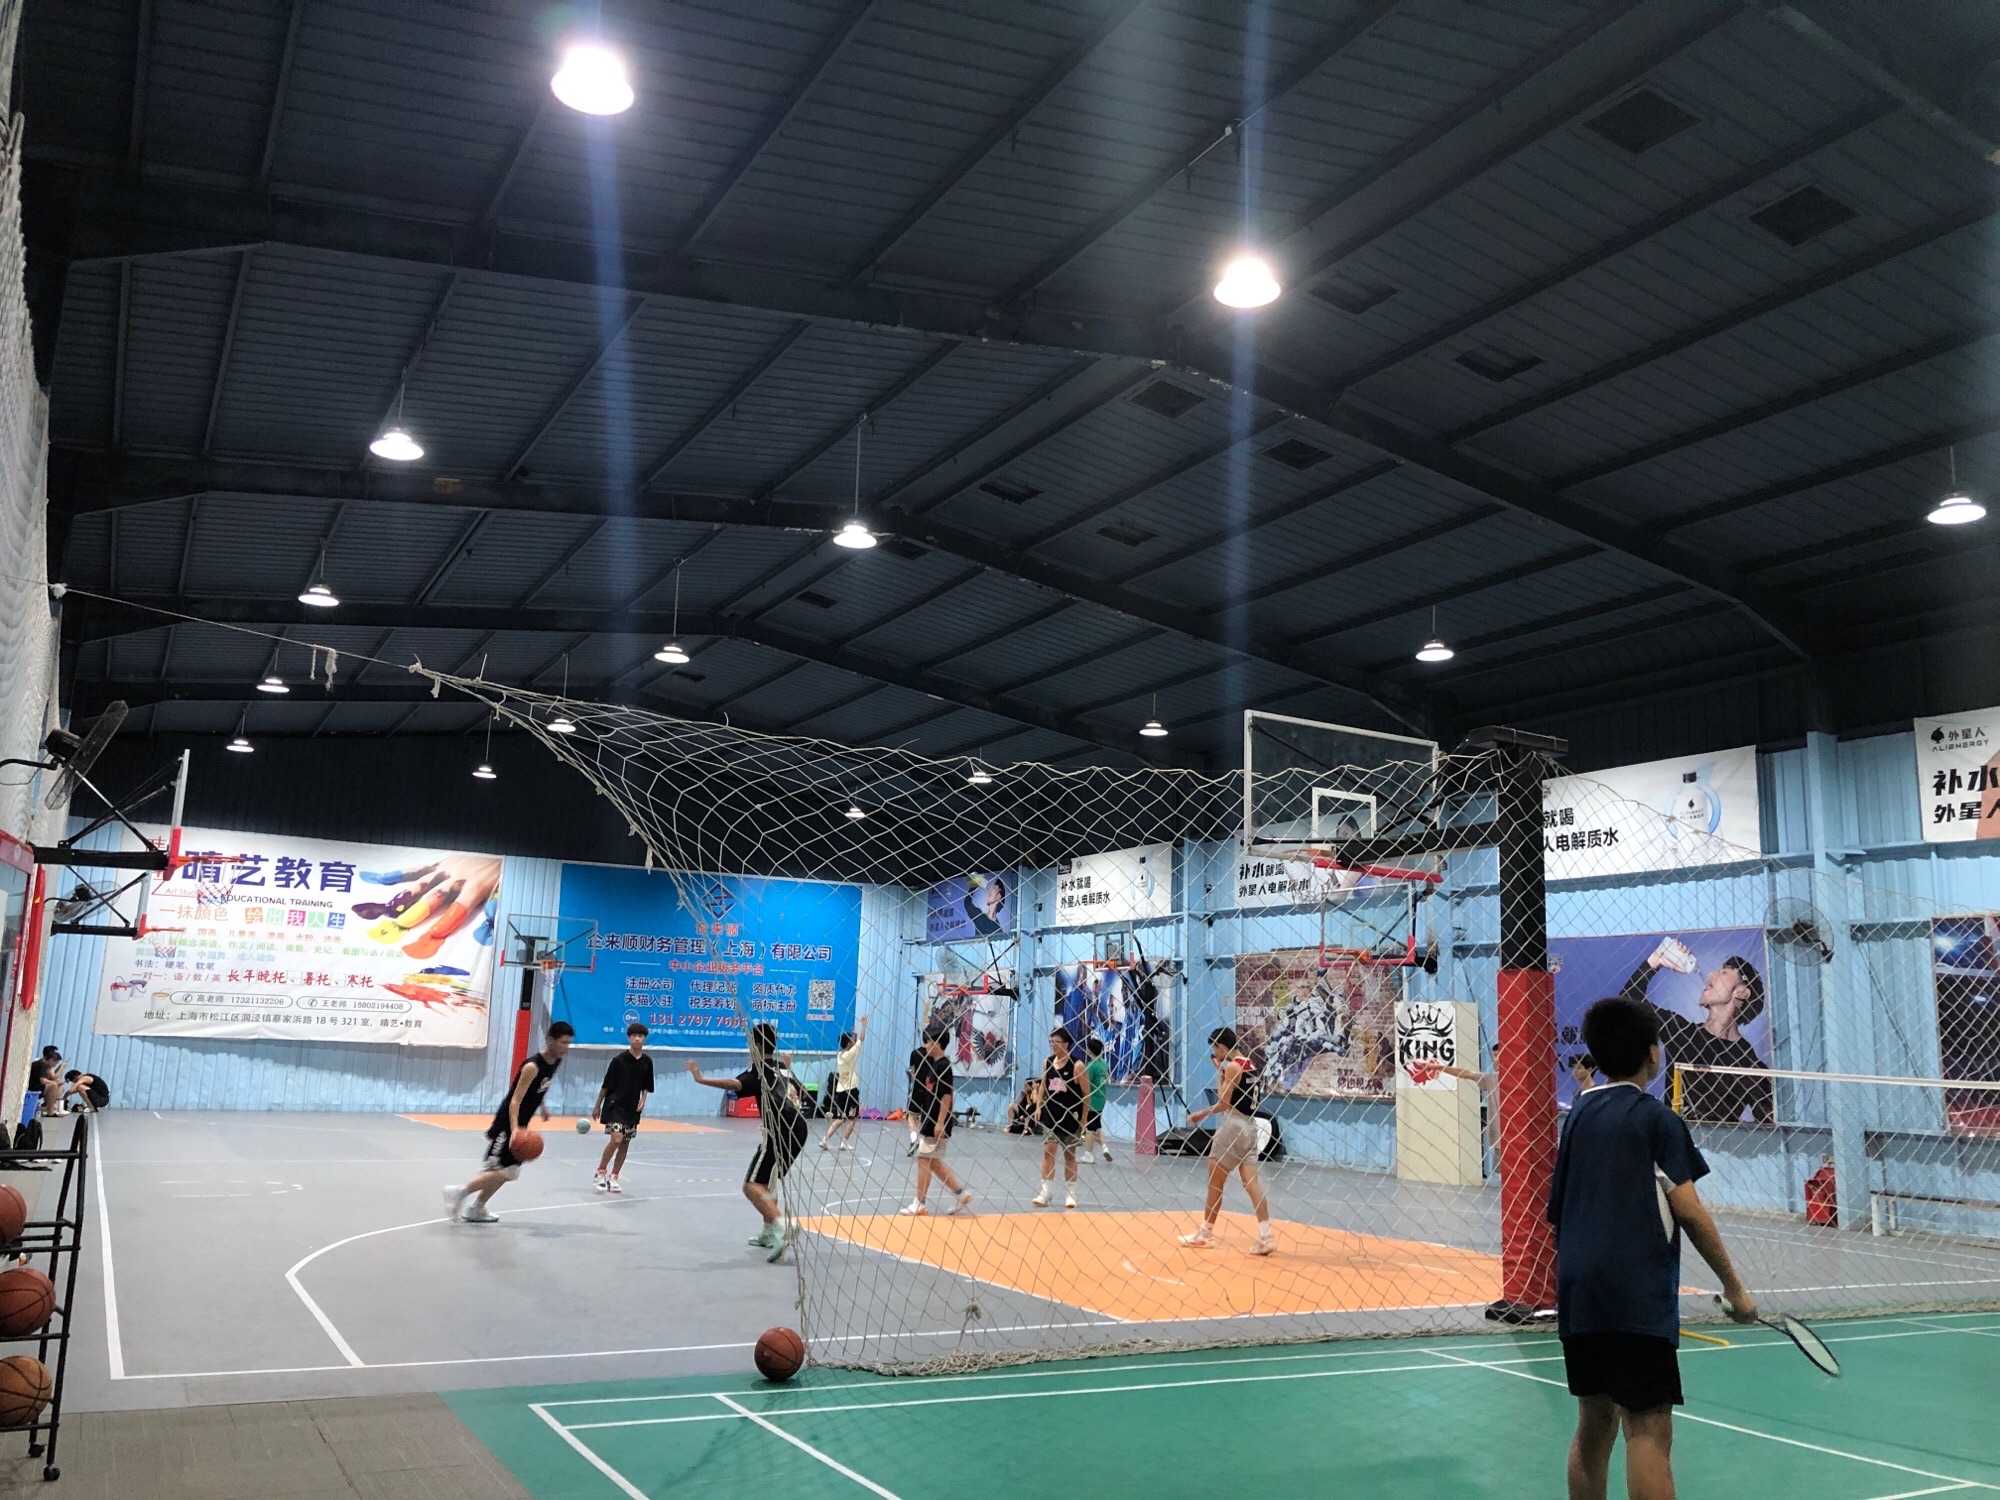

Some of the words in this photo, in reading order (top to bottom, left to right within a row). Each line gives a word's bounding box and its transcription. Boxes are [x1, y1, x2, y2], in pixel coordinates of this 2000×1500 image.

[1948, 726, 1986, 741] 外星人
[1932, 739, 1989, 752] ALIENERGY
[1933, 765, 1999, 796] 补水
[1061, 876, 1091, 892] 补水就喝
[221, 894, 286, 905] EDUCATIONAL
[290, 898, 333, 908] TRAINING
[1060, 890, 1110, 909] 外星人电解质水
[159, 904, 228, 921] 一抹颜色
[245, 907, 346, 930] 绘出我人生
[625, 976, 675, 991] 注册公司
[690, 981, 738, 993] 代理记账
[752, 984, 798, 996] 资质代办
[196, 994, 224, 1003] 高老师
[321, 999, 347, 1009] 王老师
[625, 993, 673, 1007] 天猫入驻
[689, 996, 737, 1010] 税务筹划
[751, 999, 797, 1013] 商标注册
[649, 1013, 674, 1026] 131
[678, 1013, 711, 1027] 2797
[1399, 1036, 1455, 1068] KING
